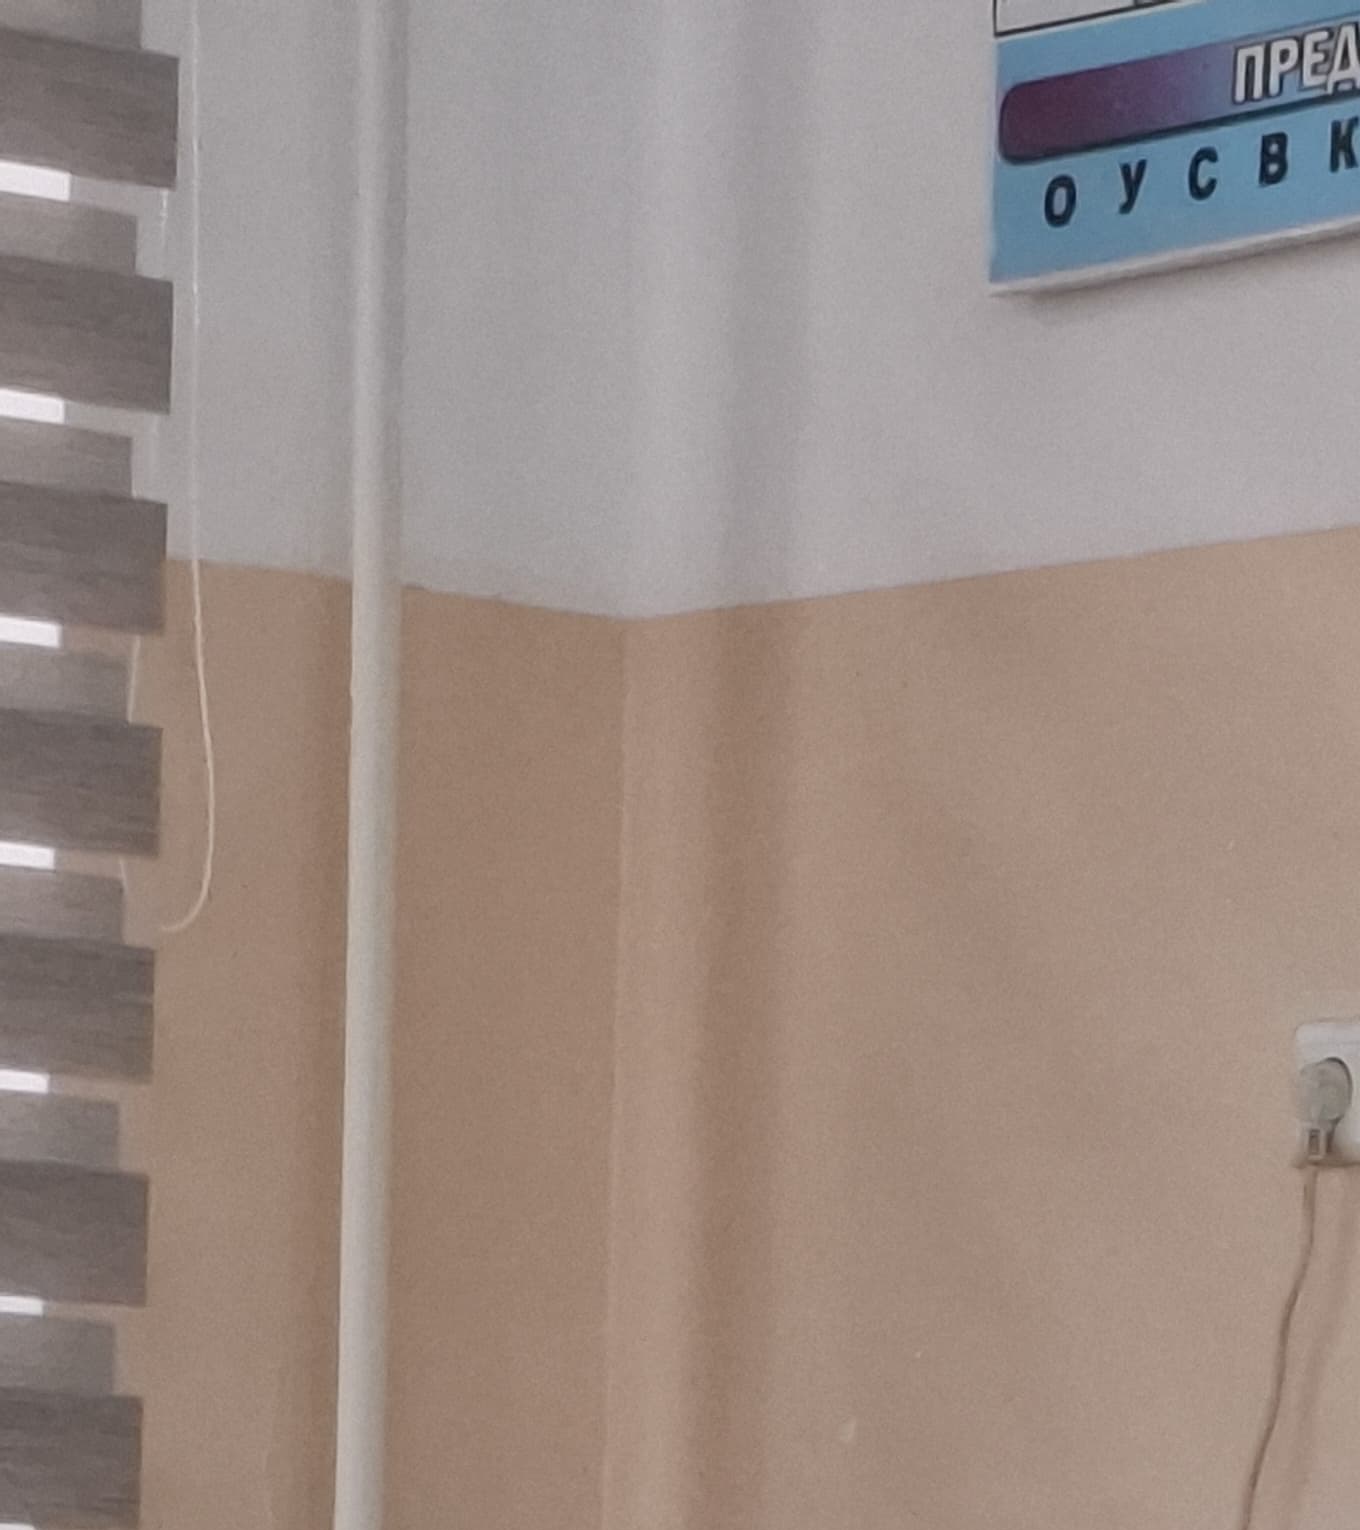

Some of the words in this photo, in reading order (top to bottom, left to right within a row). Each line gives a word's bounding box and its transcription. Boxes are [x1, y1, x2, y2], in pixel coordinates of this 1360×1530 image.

[1044, 174, 1077, 228] О
[1118, 158, 1147, 214] У
[1188, 146, 1218, 200] С
[1259, 132, 1288, 186] В
[1329, 116, 1360, 172] К
